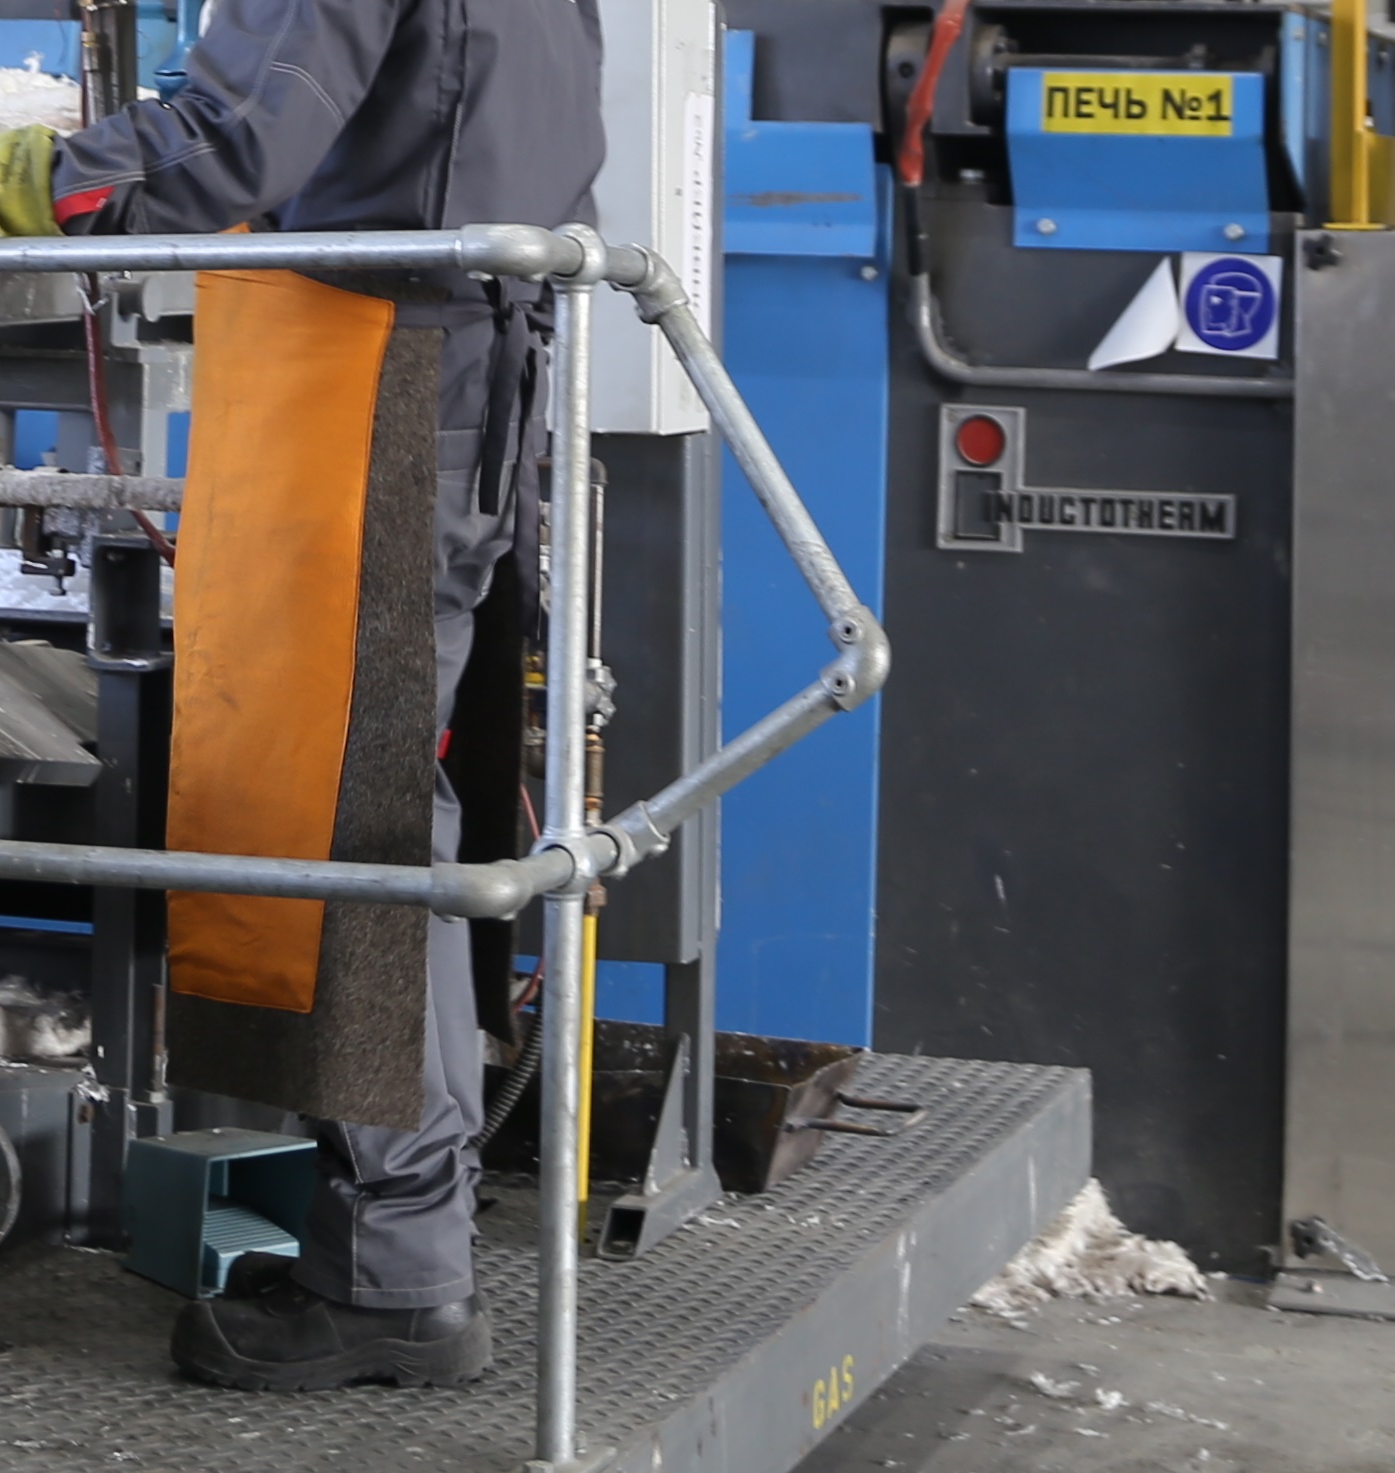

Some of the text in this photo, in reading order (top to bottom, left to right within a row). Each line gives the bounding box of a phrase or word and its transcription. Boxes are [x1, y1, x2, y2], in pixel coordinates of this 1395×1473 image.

[1046, 85, 1232, 121] ПЕЧЬ №1
[985, 491, 1227, 534] INDUCTOTHERM
[812, 1354, 854, 1429] GAS
